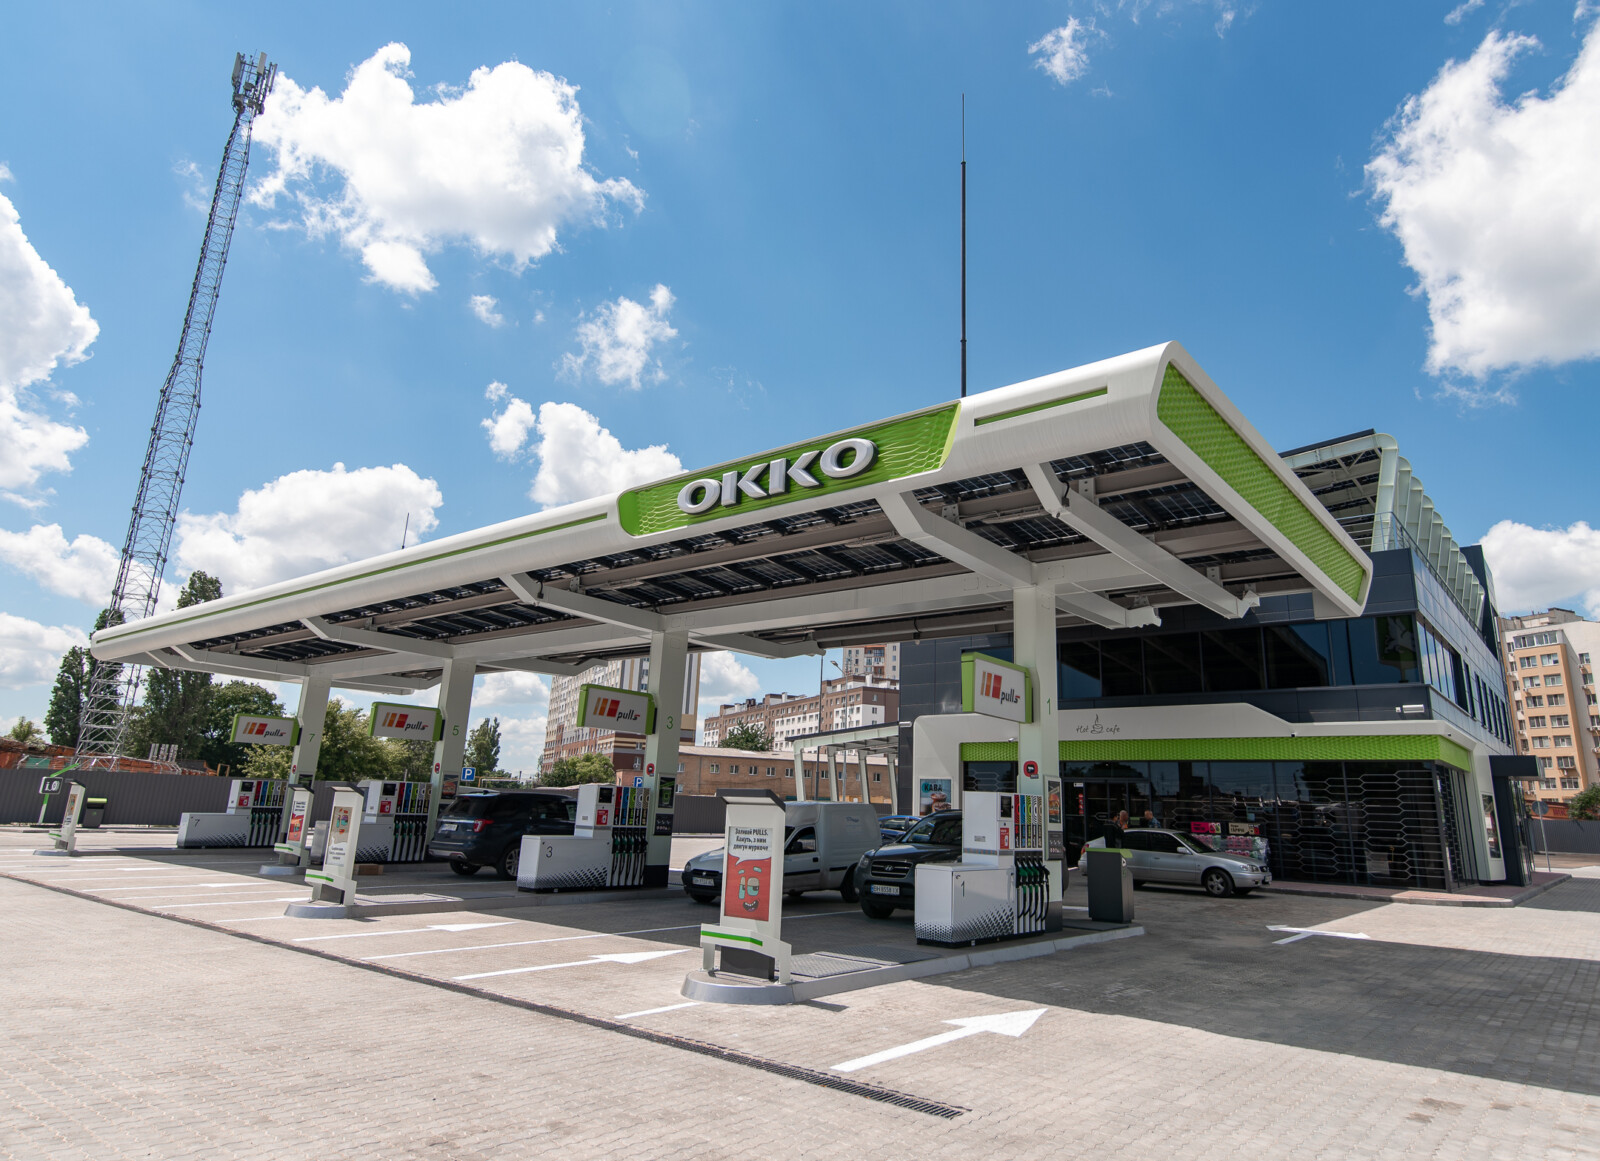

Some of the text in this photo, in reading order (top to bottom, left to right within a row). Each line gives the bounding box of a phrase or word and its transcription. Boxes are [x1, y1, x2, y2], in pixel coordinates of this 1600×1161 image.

[677, 437, 878, 516] OKKO
[1000, 688, 1020, 704] pulls
[1046, 697, 1051, 715] 1
[616, 709, 640, 722] pulls
[404, 721, 428, 731] pulls
[666, 716, 674, 730] 3
[1076, 724, 1120, 735] Hot cafe
[452, 725, 460, 736] 5
[308, 733, 315, 743] 7
[464, 769, 472, 779] P
[194, 819, 201, 827] 7
[546, 845, 553, 858] 3
[960, 880, 965, 898] 1
